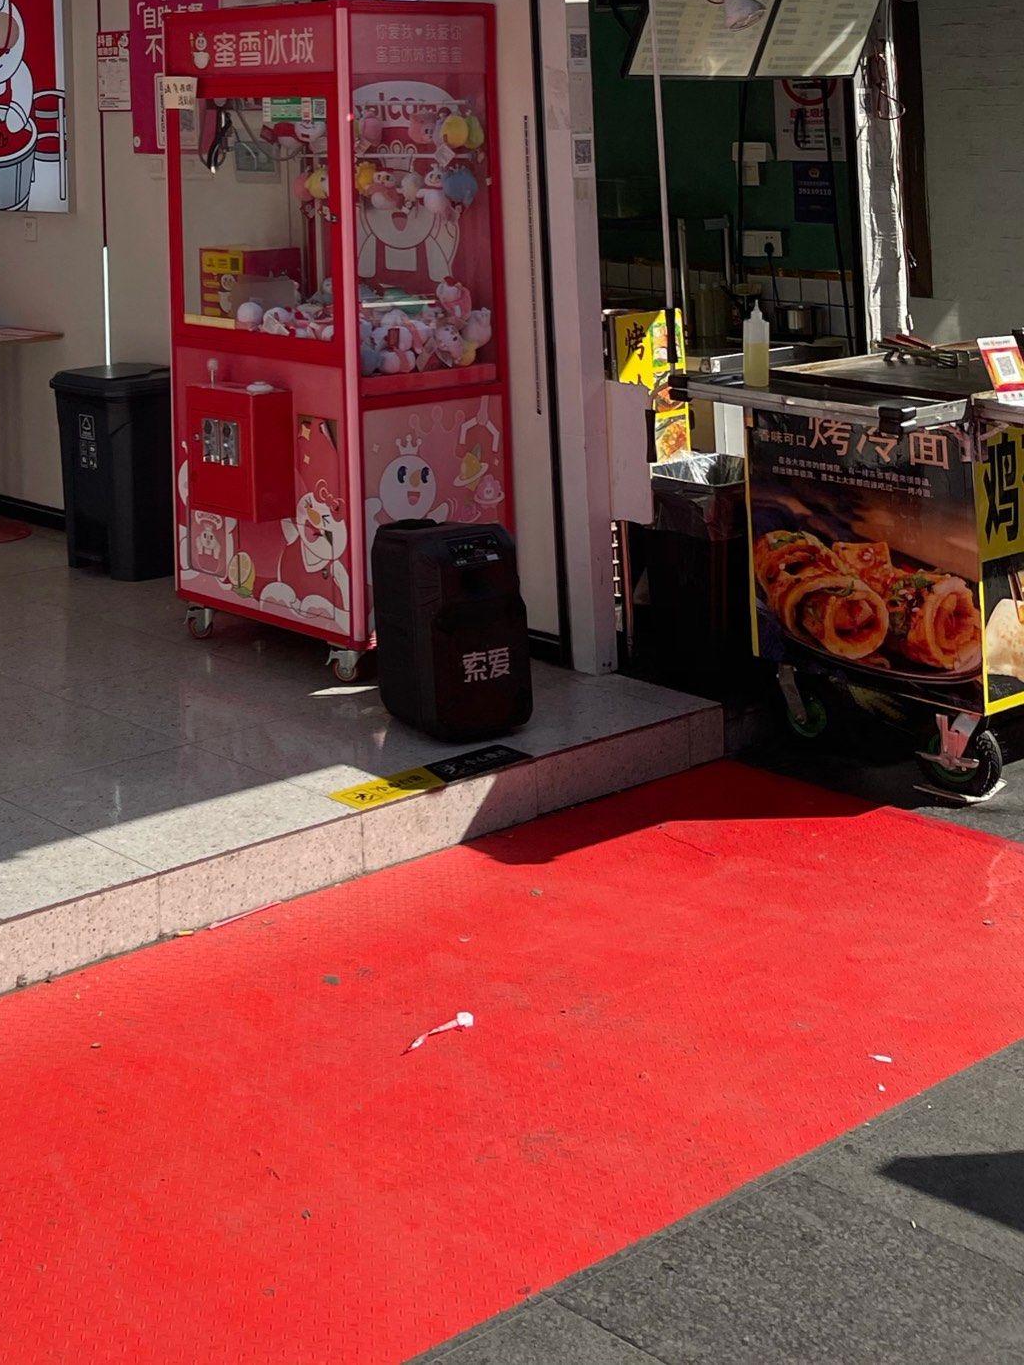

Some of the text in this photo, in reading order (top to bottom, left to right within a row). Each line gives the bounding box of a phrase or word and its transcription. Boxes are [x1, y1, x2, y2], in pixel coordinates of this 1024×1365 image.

[212, 27, 315, 69] 蜜雪冰城
[625, 322, 646, 364] 烤
[759, 428, 807, 447] 香味可口
[982, 433, 1024, 545] 鸡
[461, 646, 511, 683] 索爱
